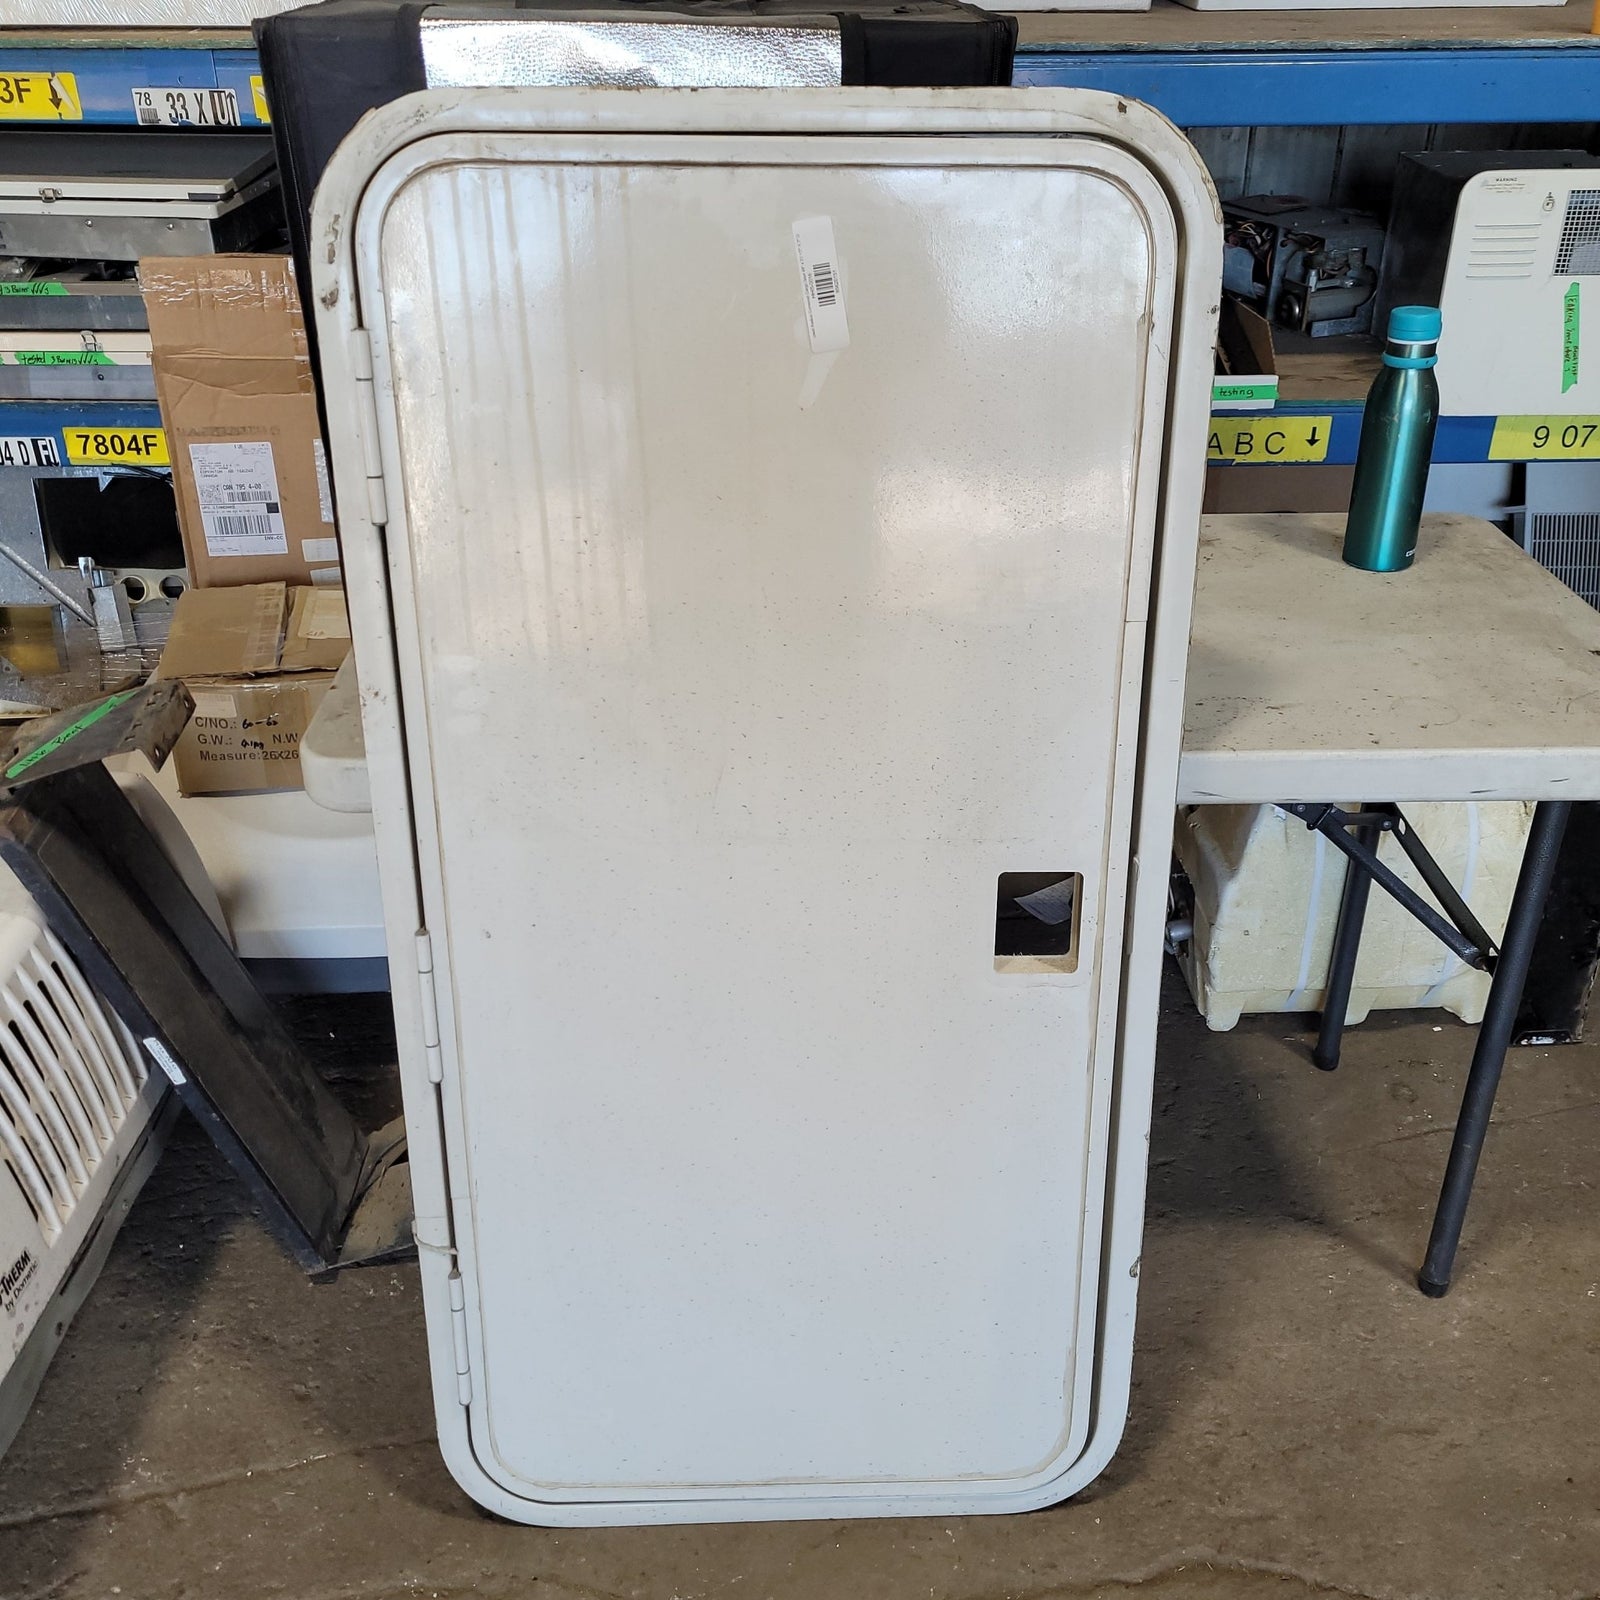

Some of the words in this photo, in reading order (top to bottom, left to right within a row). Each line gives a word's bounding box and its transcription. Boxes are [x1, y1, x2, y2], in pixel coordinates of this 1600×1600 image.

[135, 92, 152, 106] 78
[166, 92, 189, 124] 33
[194, 93, 208, 124] X
[1219, 389, 1254, 398] testing
[76, 434, 157, 456] 7804F
[1234, 432, 1254, 455] B
[1265, 431, 1286, 455] C
[1533, 425, 1550, 448] 9
[1562, 425, 1598, 448] 07
[18, 440, 30, 466] D
[197, 734, 233, 745] G.W.:
